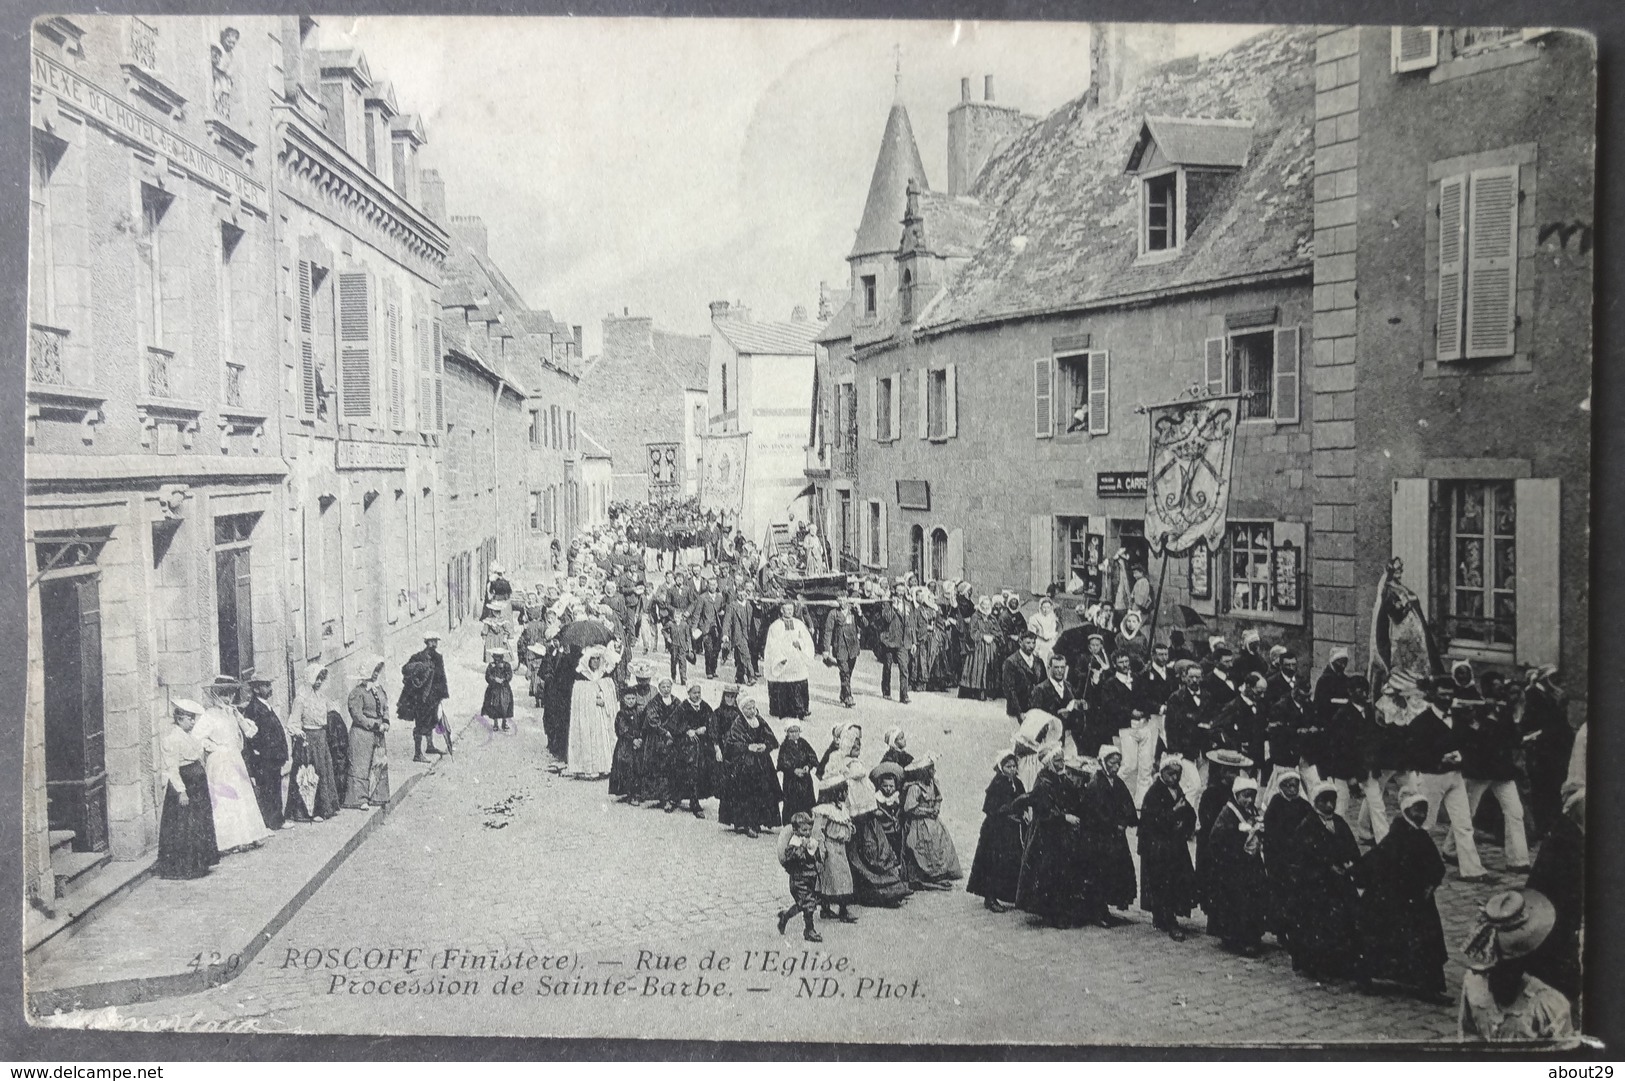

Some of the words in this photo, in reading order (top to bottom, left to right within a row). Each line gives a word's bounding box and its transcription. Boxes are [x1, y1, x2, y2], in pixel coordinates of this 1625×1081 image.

[89, 91, 102, 115] DE
[183, 143, 214, 178] BAINS
[218, 166, 231, 187] DE
[234, 174, 258, 204] MER
